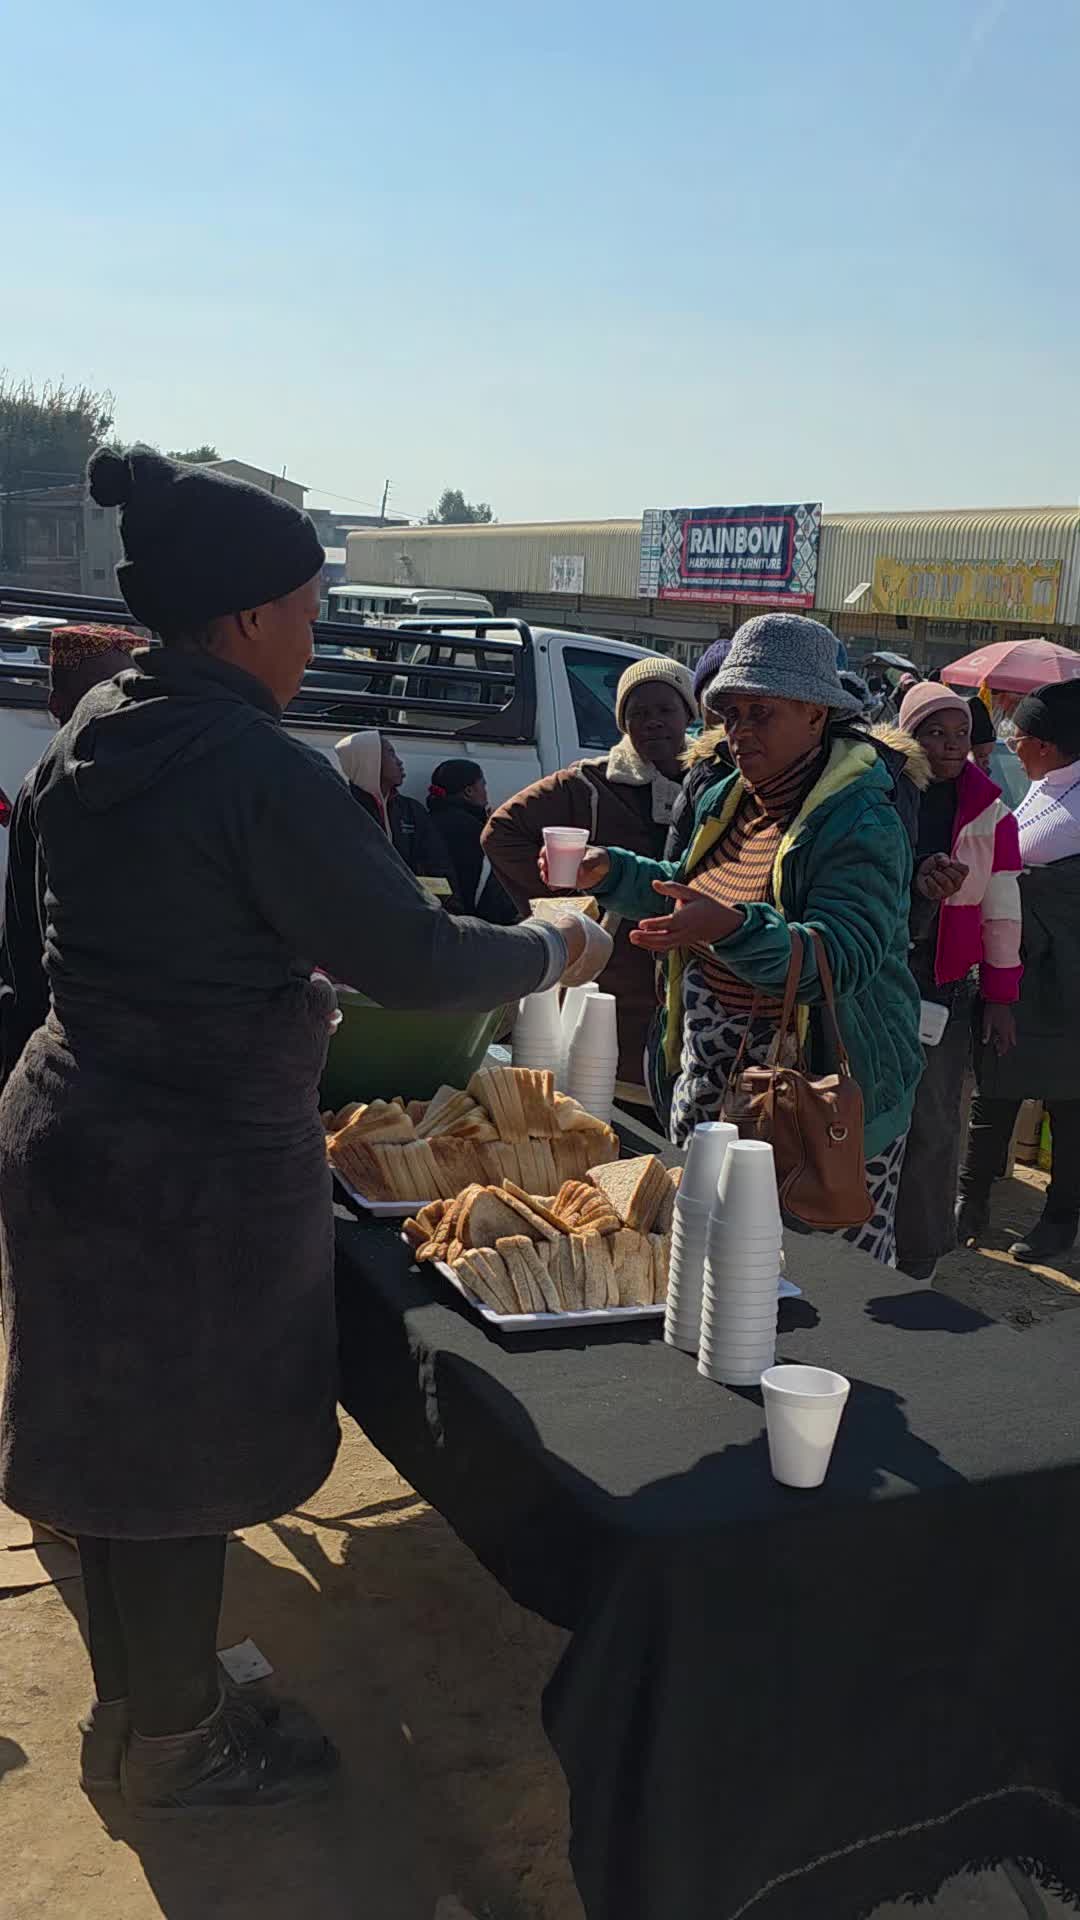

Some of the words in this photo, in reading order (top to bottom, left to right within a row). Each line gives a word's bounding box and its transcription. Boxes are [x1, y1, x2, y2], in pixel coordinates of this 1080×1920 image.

[690, 526, 783, 553] RAINBOW
[688, 557, 730, 569] HARDWARE
[731, 558, 736, 569] &
[737, 557, 782, 569] FURNITURE
